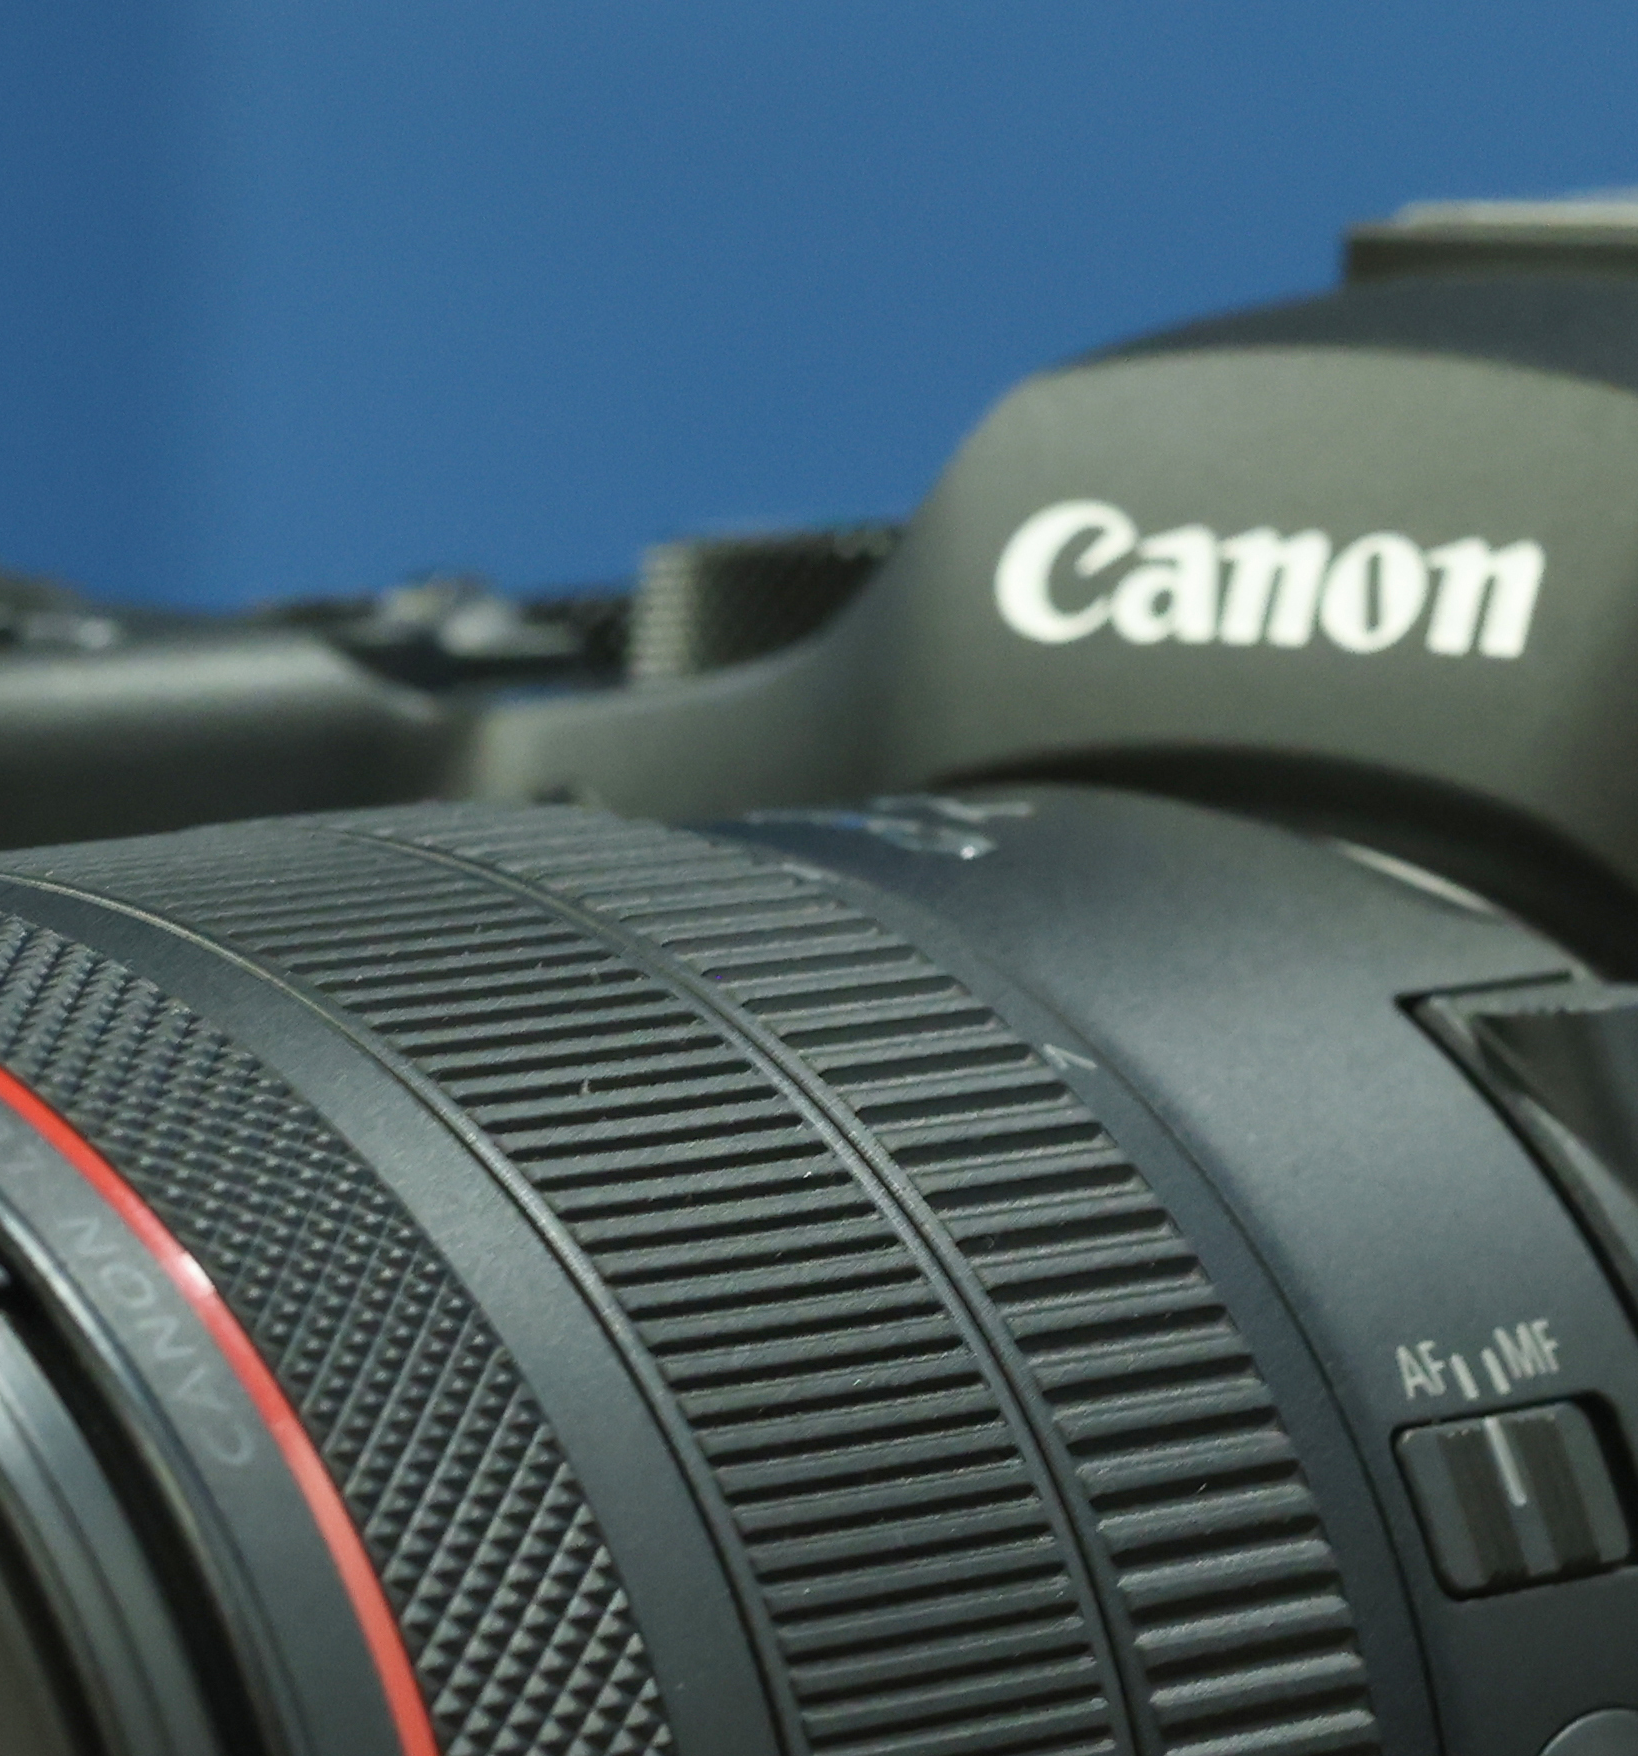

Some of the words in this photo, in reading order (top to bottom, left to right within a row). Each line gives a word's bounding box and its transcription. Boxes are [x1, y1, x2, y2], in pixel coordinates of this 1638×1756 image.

[994, 499, 1546, 659] Canon
[56, 1215, 256, 1468] CANON
[1395, 1339, 1447, 1400] AF
[1493, 1317, 1560, 1380] MF
